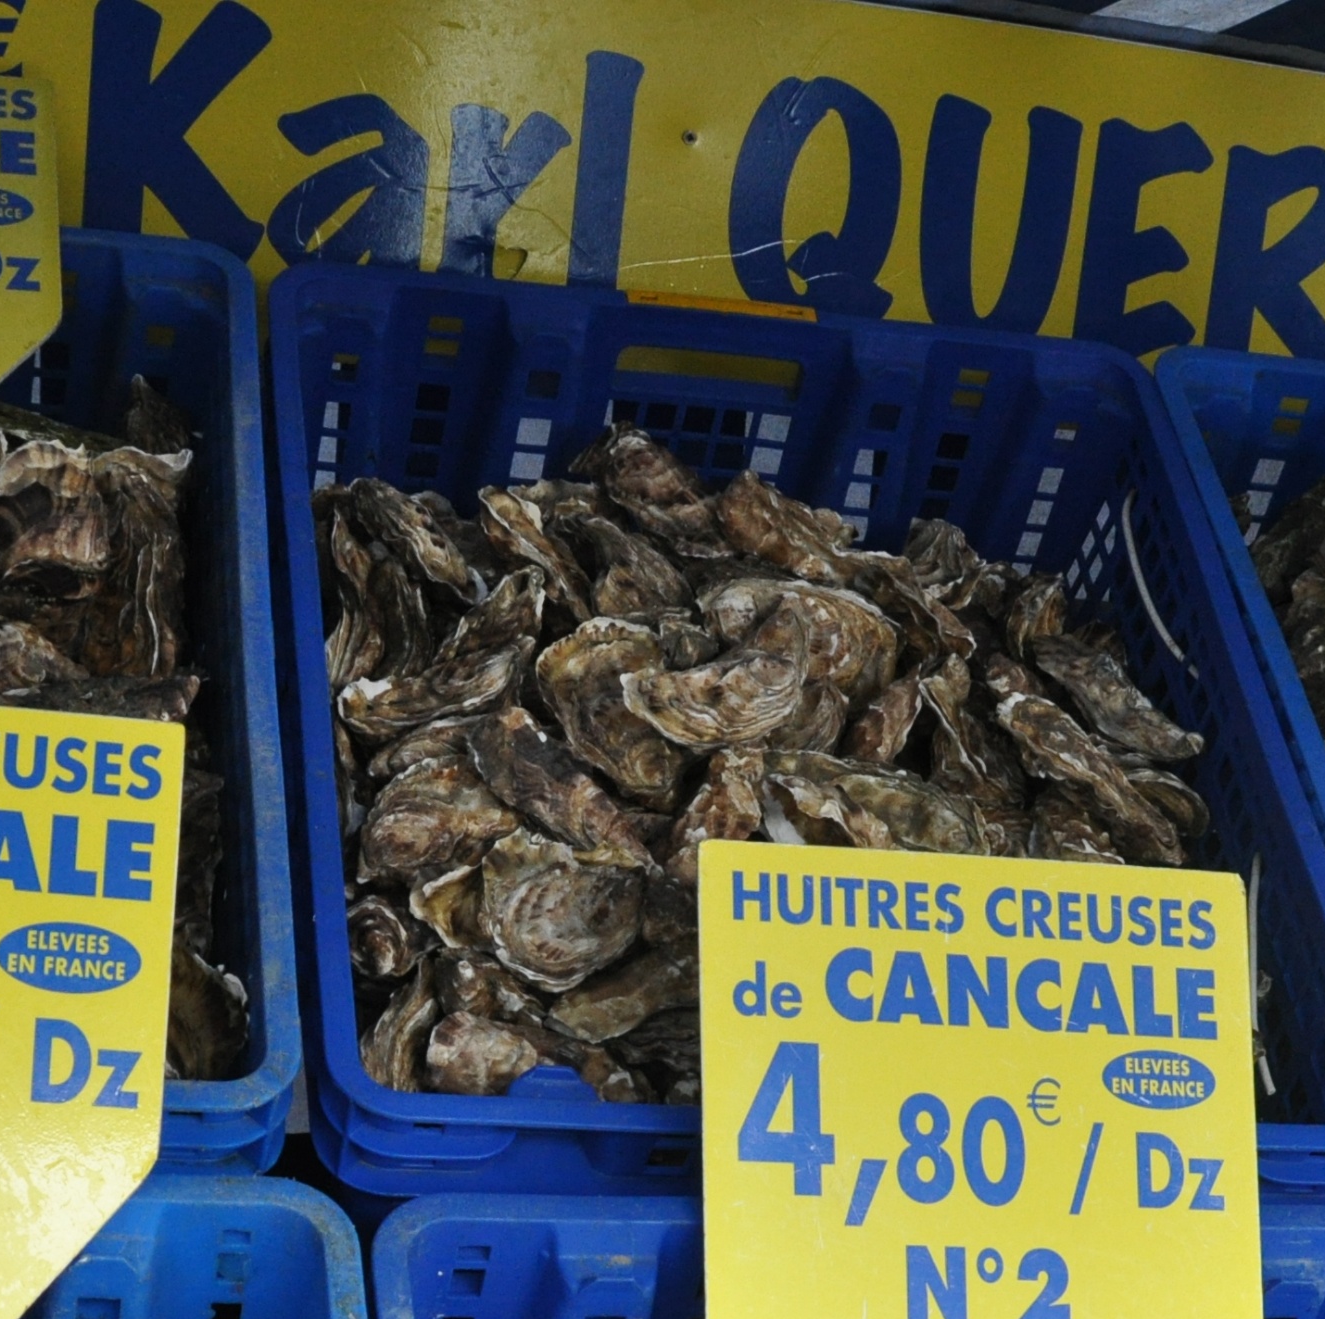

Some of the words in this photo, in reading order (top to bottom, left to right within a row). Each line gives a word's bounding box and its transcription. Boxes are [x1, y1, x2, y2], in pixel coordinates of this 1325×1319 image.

[82, 0, 644, 290] Karl
[732, 870, 965, 934] HUITRES
[984, 887, 1216, 950] CREUSES
[26, 929, 110, 955] ELEVEES
[7, 953, 37, 974] EN
[43, 956, 126, 982] FRANCE
[732, 961, 802, 1019] de
[825, 947, 1218, 1040] CANCALE
[1124, 1057, 1190, 1077] ELEVEES
[1111, 1077, 1136, 1095] EN
[1140, 1079, 1204, 1099] FRANCE
